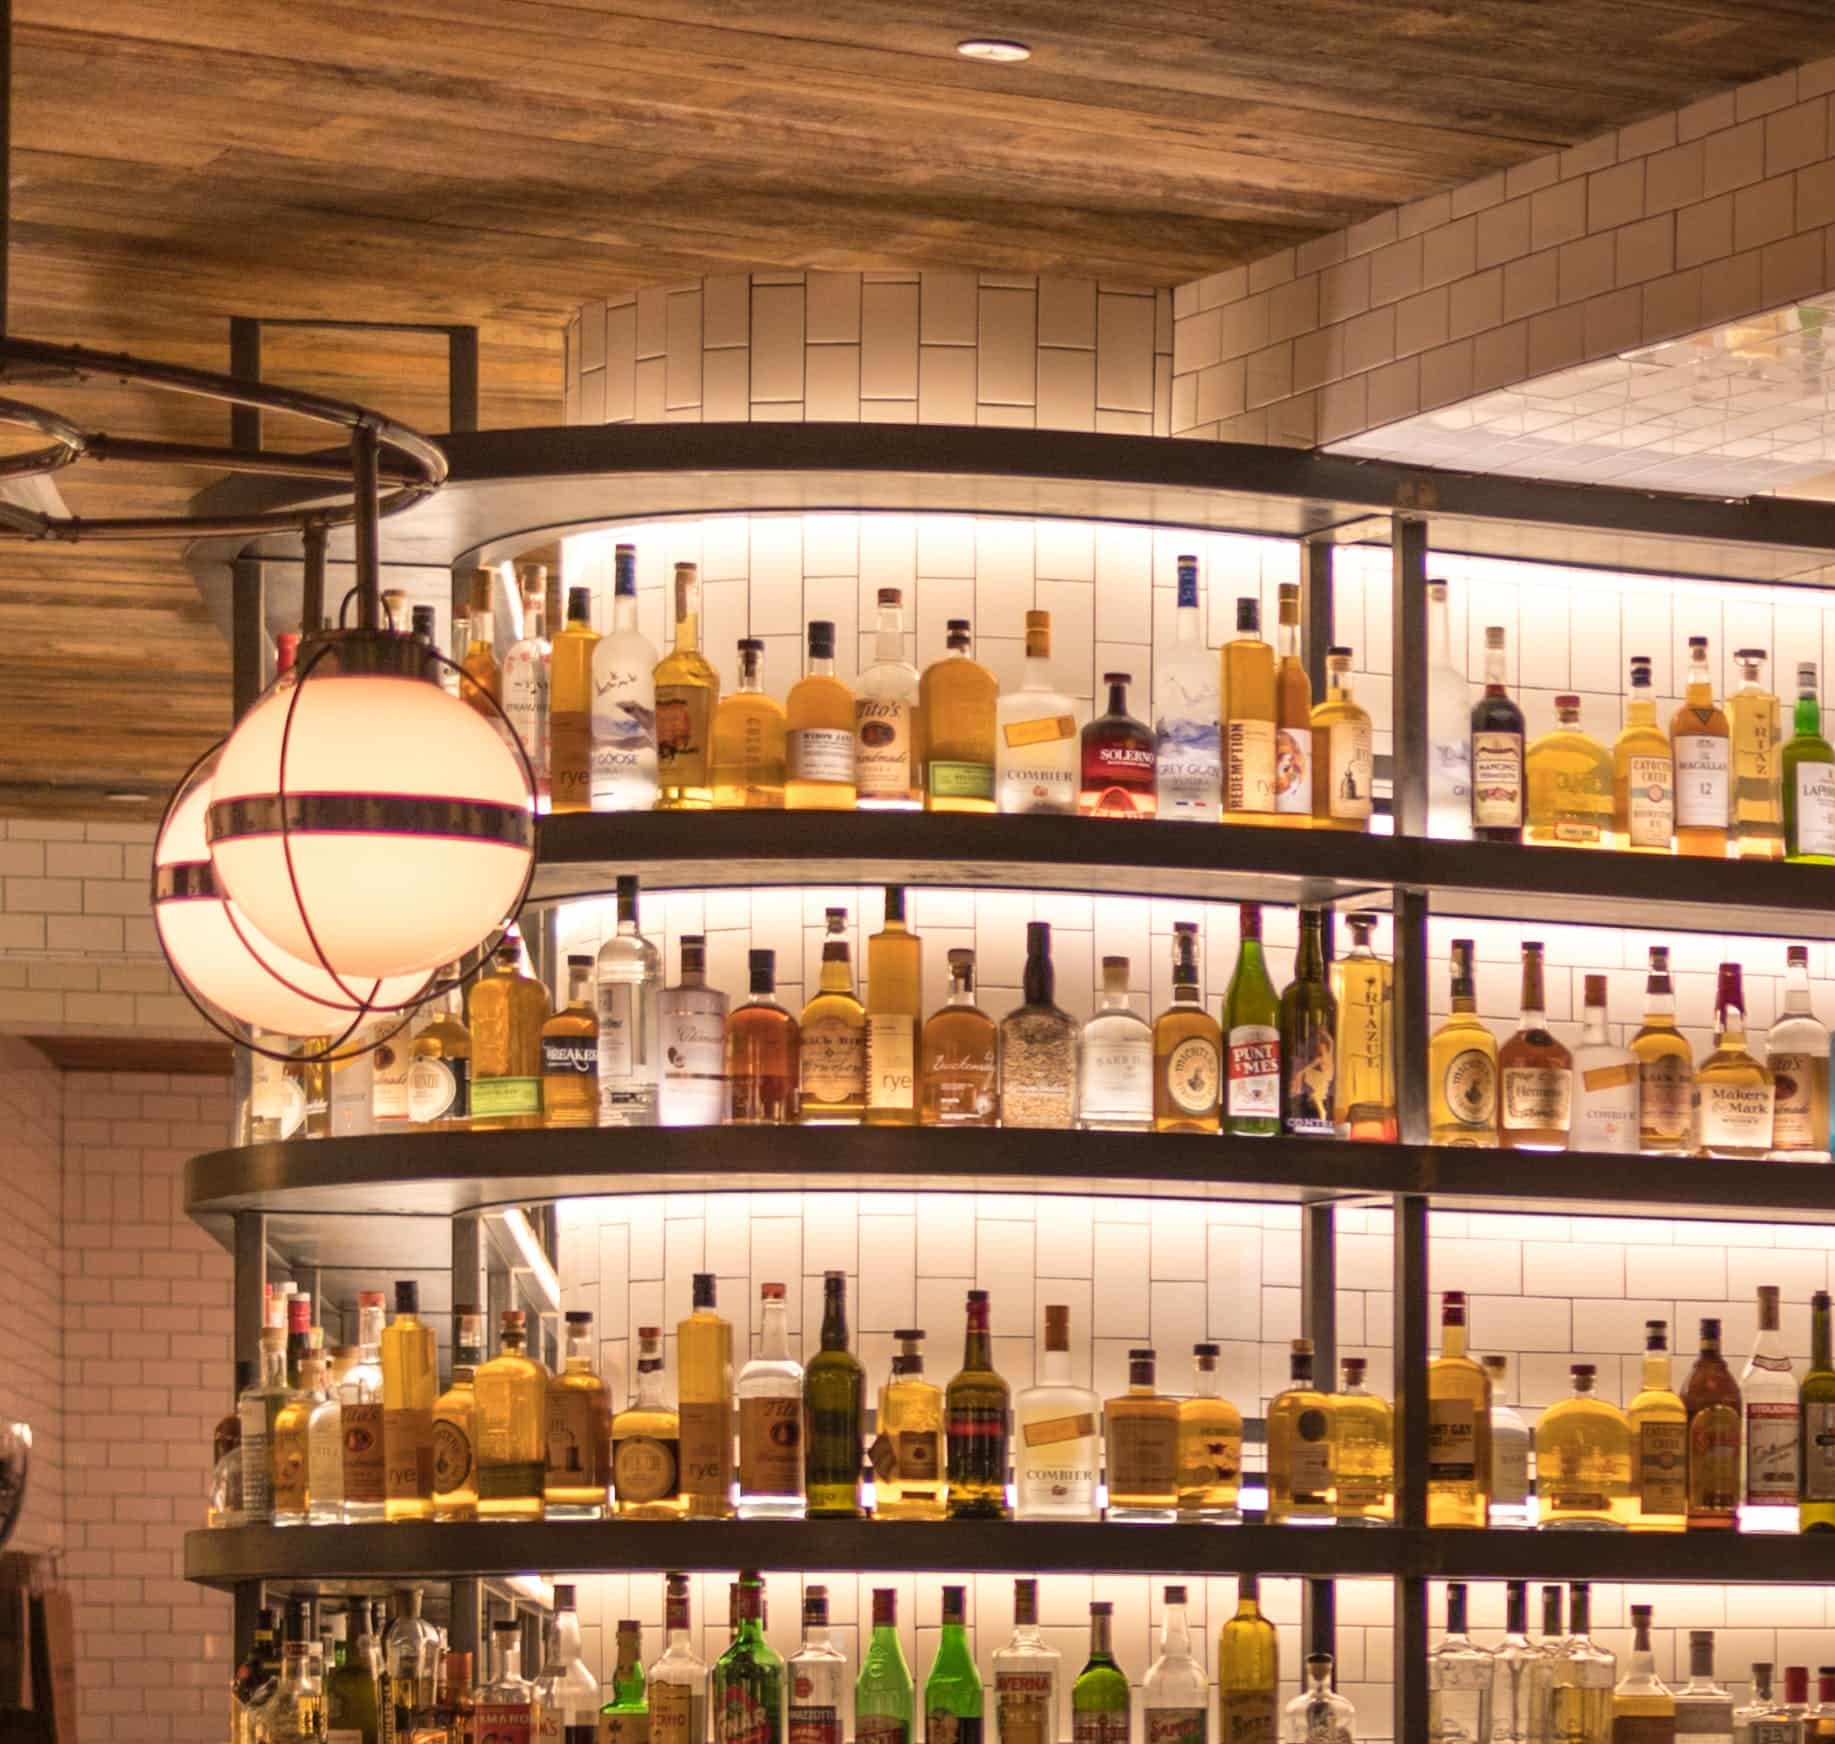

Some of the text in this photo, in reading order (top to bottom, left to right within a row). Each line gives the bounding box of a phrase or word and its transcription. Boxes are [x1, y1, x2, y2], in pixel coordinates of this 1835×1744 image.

[1100, 749, 1155, 764] SOLERNO
[1230, 721, 1245, 809] REDEMPTION
[560, 767, 590, 789] rye
[1006, 769, 1073, 783] COMBIER
[1699, 781, 1713, 795] 12
[1232, 1045, 1274, 1064] PUNT
[1244, 1059, 1280, 1075] MES
[883, 1073, 913, 1092] rye
[1728, 1102, 1767, 1115] Mark
[689, 1462, 720, 1482] rye
[1026, 1469, 1093, 1483] COMBIER
